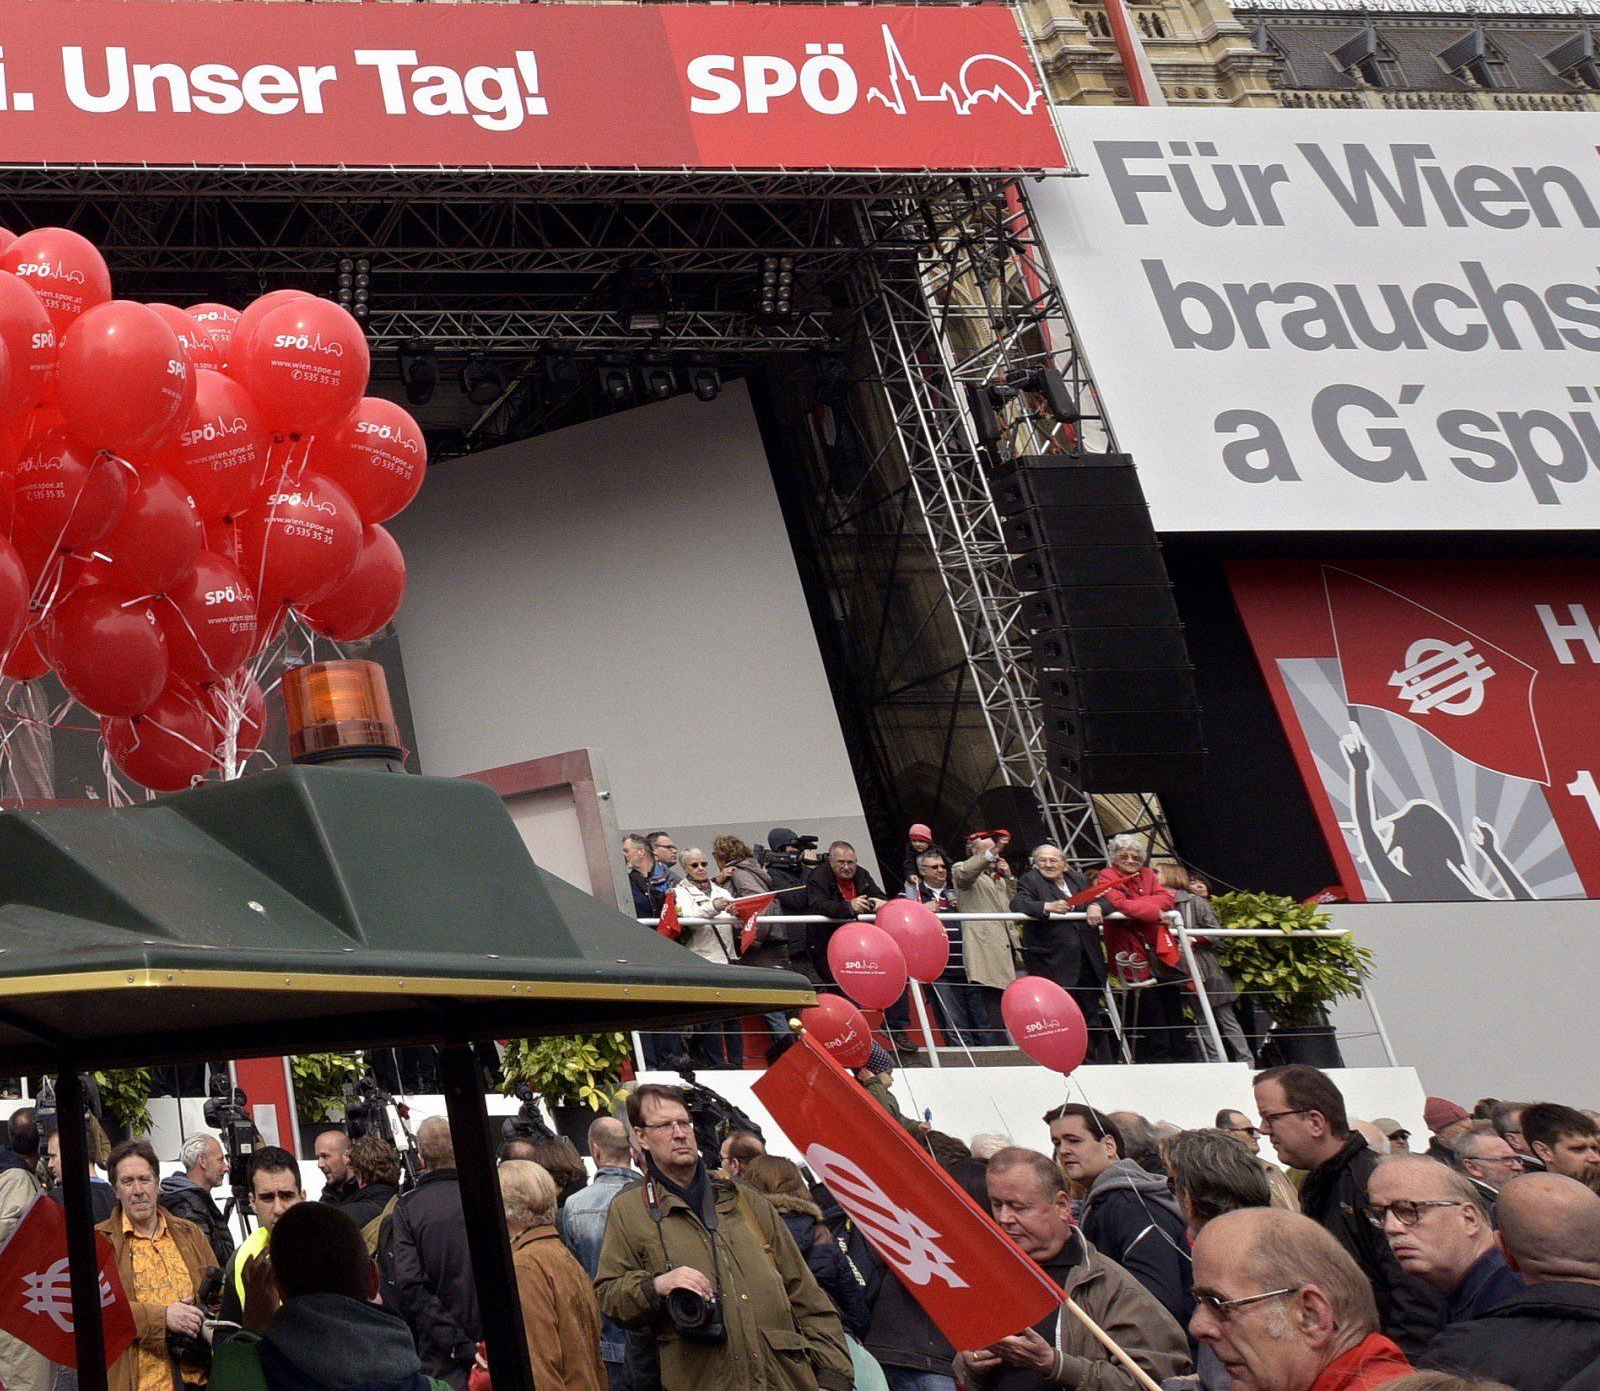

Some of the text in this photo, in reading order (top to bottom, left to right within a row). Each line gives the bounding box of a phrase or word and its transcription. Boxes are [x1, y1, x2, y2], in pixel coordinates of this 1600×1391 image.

[64, 46, 336, 115] Unser
[354, 48, 548, 131] Tag!
[687, 43, 859, 116] SPÖ
[1093, 141, 1600, 229] Für Wien
[16, 262, 50, 278] SPÖ
[61, 301, 71, 311] 35
[72, 303, 81, 314] 35
[1141, 259, 1600, 352] brauchs
[32, 329, 54, 349] SPÖ
[274, 334, 308, 350] SPÖ
[303, 372, 340, 386] 535 35 35
[181, 423, 216, 447] SPÖ
[355, 421, 391, 439] SPÖ
[1214, 409, 1302, 484] a
[223, 458, 237, 469] 535
[381, 459, 395, 471] 535
[267, 493, 301, 506] SPÖ
[296, 527, 310, 537] 535
[312, 530, 322, 541] 35
[205, 587, 235, 605] SPÖ
[1535, 604, 1600, 664] H
